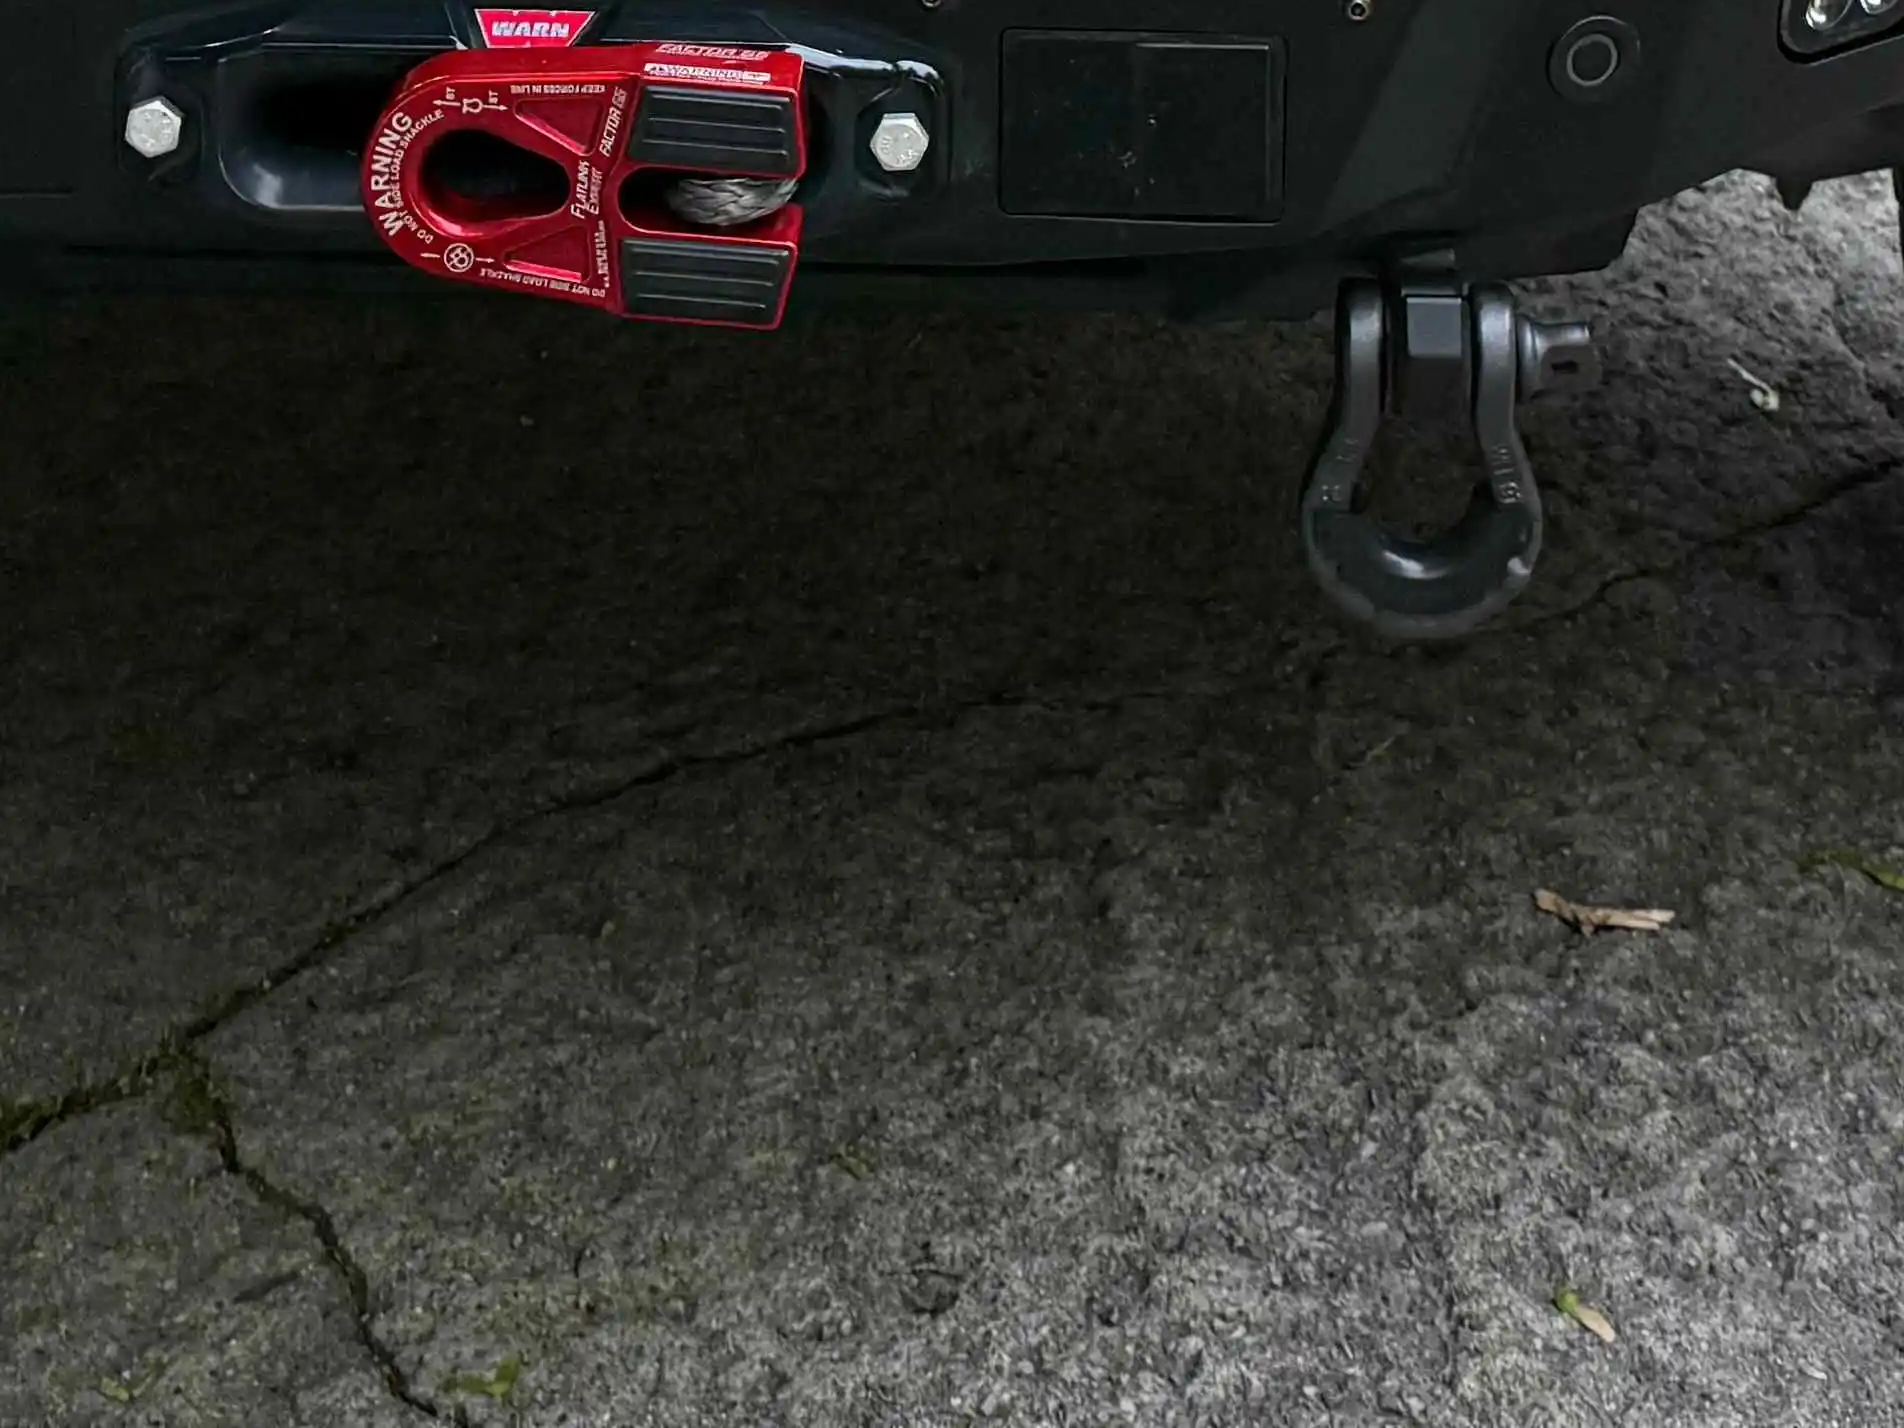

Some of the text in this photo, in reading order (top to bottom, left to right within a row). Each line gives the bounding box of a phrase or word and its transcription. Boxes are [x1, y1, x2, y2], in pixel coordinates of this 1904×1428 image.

[491, 20, 570, 38] WARN
[399, 108, 445, 150] SHACKLE
[599, 106, 624, 158] FACTOR
[370, 111, 413, 237] WARNING
[391, 147, 405, 181] LOAD
[399, 209, 419, 231] NOT
[417, 228, 434, 245] DO
